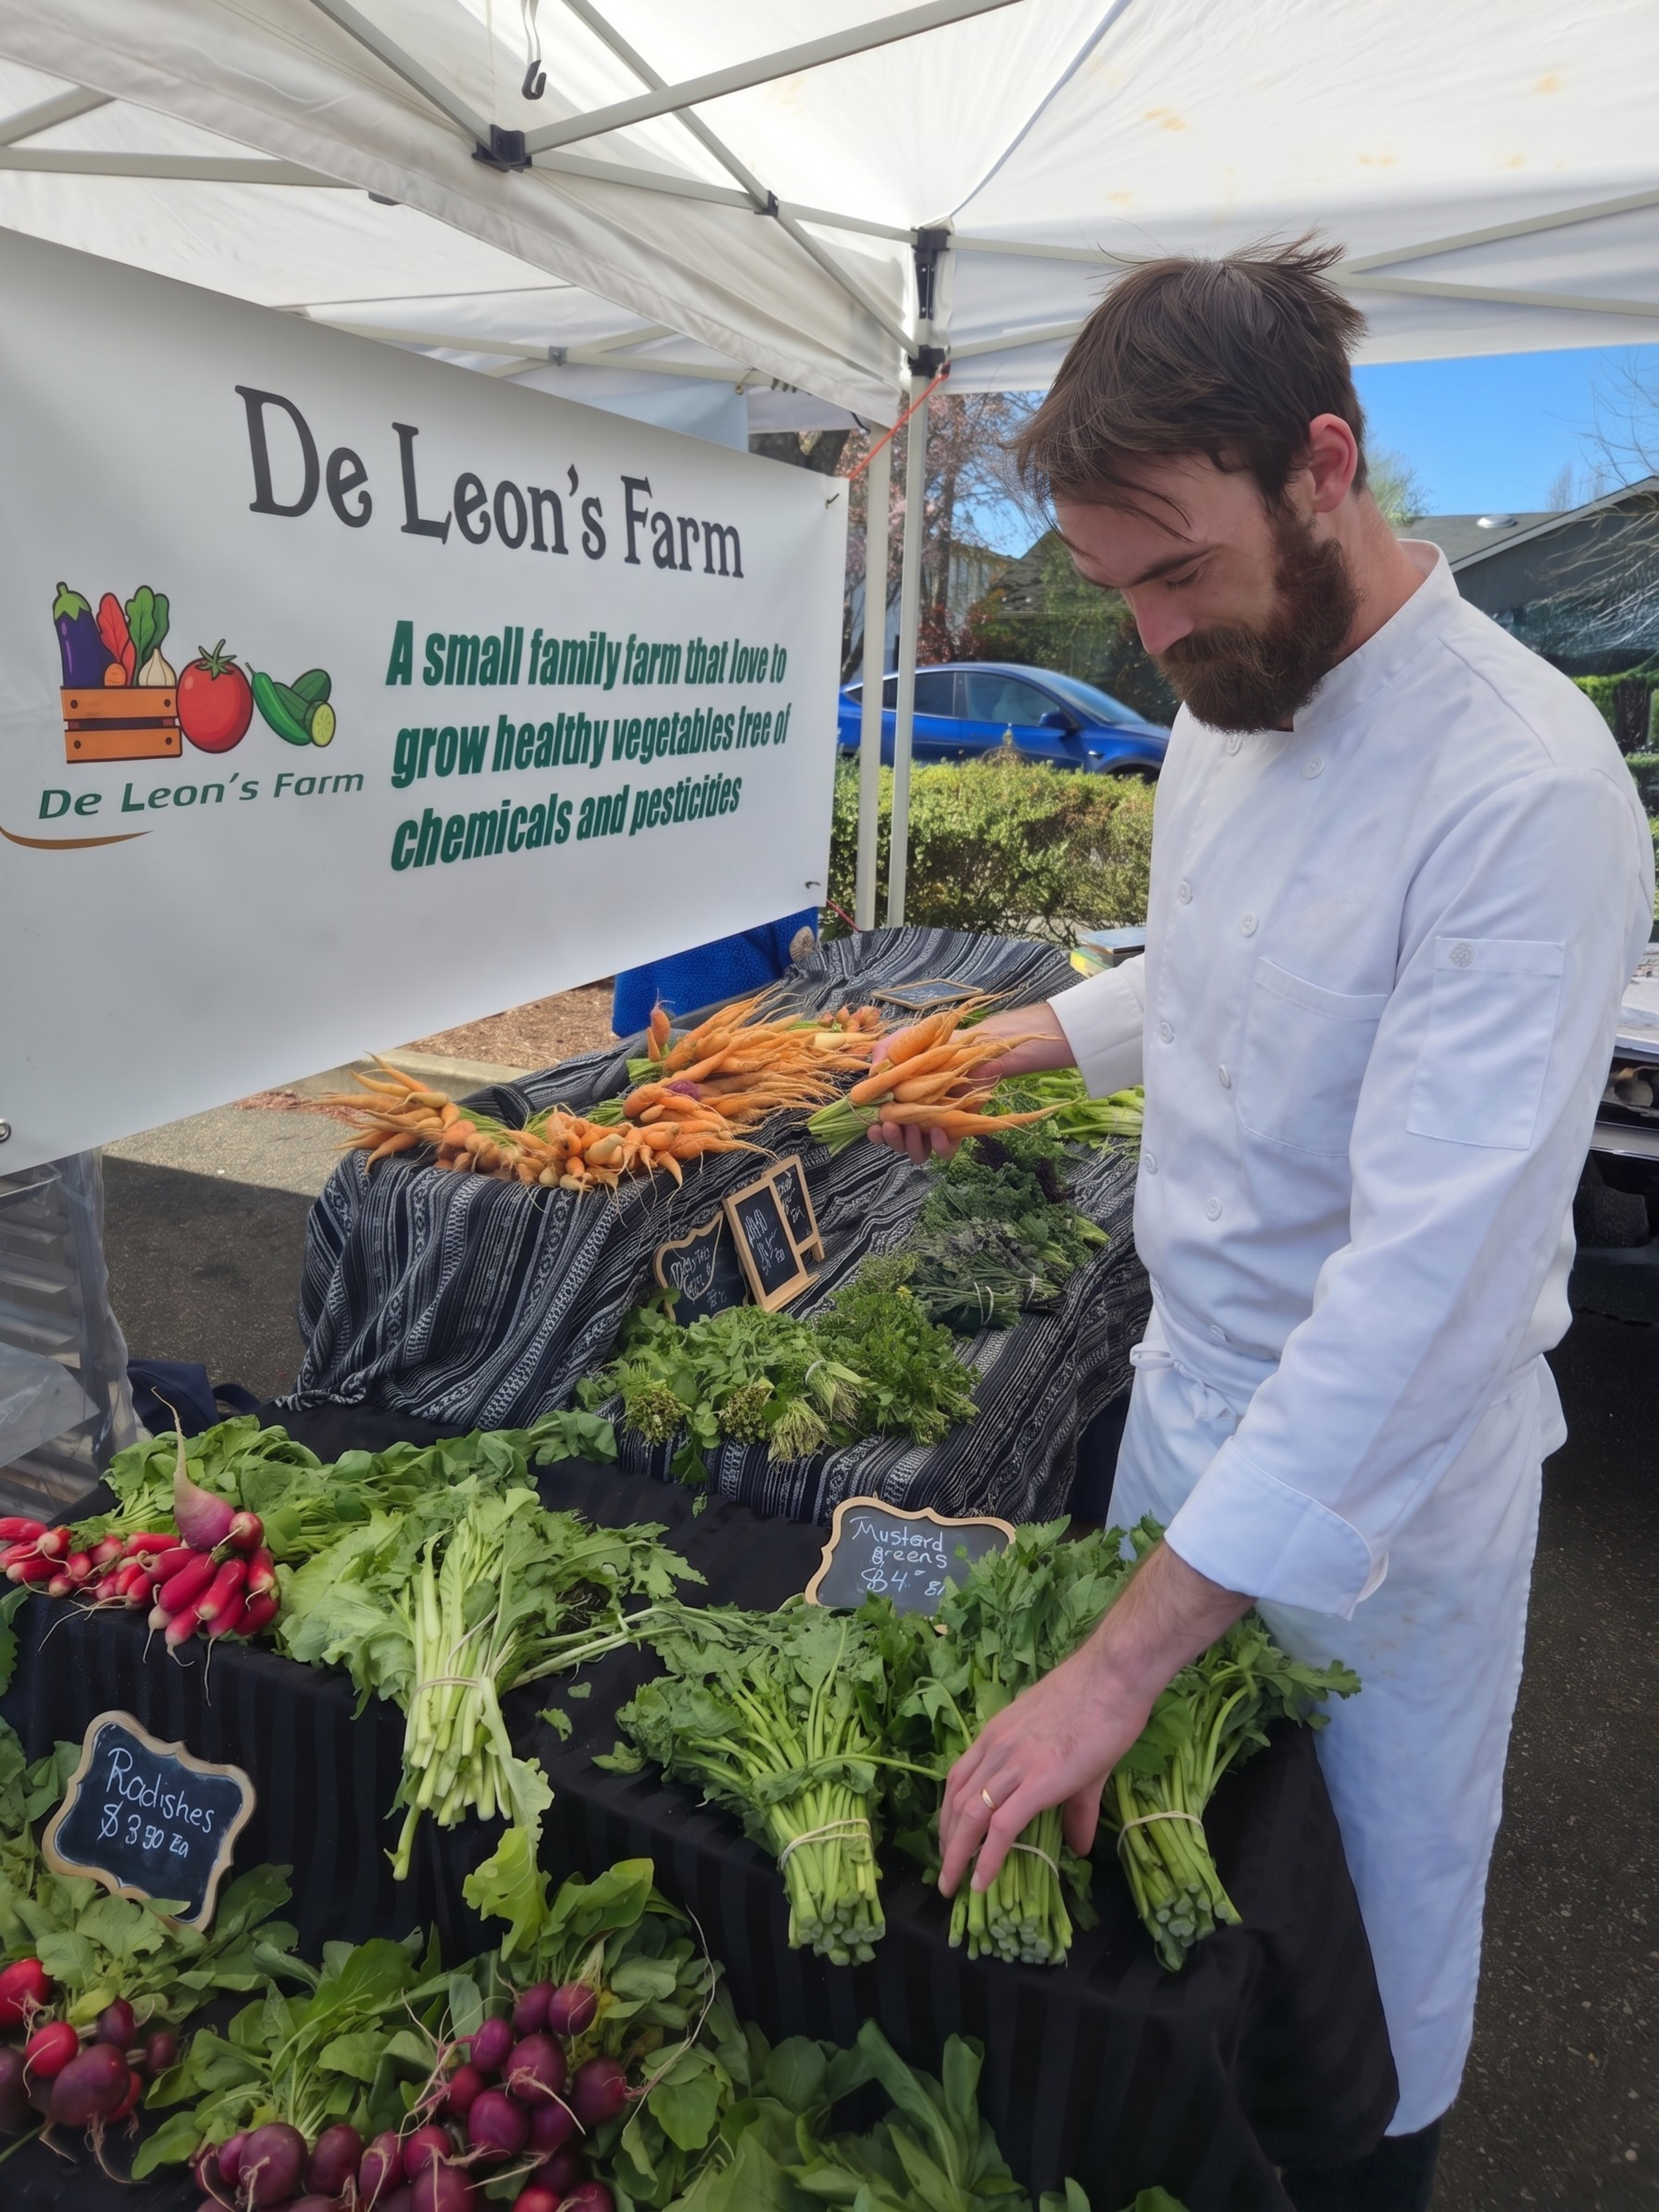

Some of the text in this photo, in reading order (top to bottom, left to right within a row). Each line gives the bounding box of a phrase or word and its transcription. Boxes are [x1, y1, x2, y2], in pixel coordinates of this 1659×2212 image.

[234, 384, 745, 579] De Leon's Farm
[384, 620, 788, 691] A small family farm that love to
[390, 702, 792, 790] grow healthy vegetables free of
[38, 764, 364, 820] De Leon's Farm
[390, 792, 573, 872] chemicals
[575, 784, 630, 841] and
[849, 1516, 943, 1553] Mustard
[107, 1747, 214, 1833] Radishes
